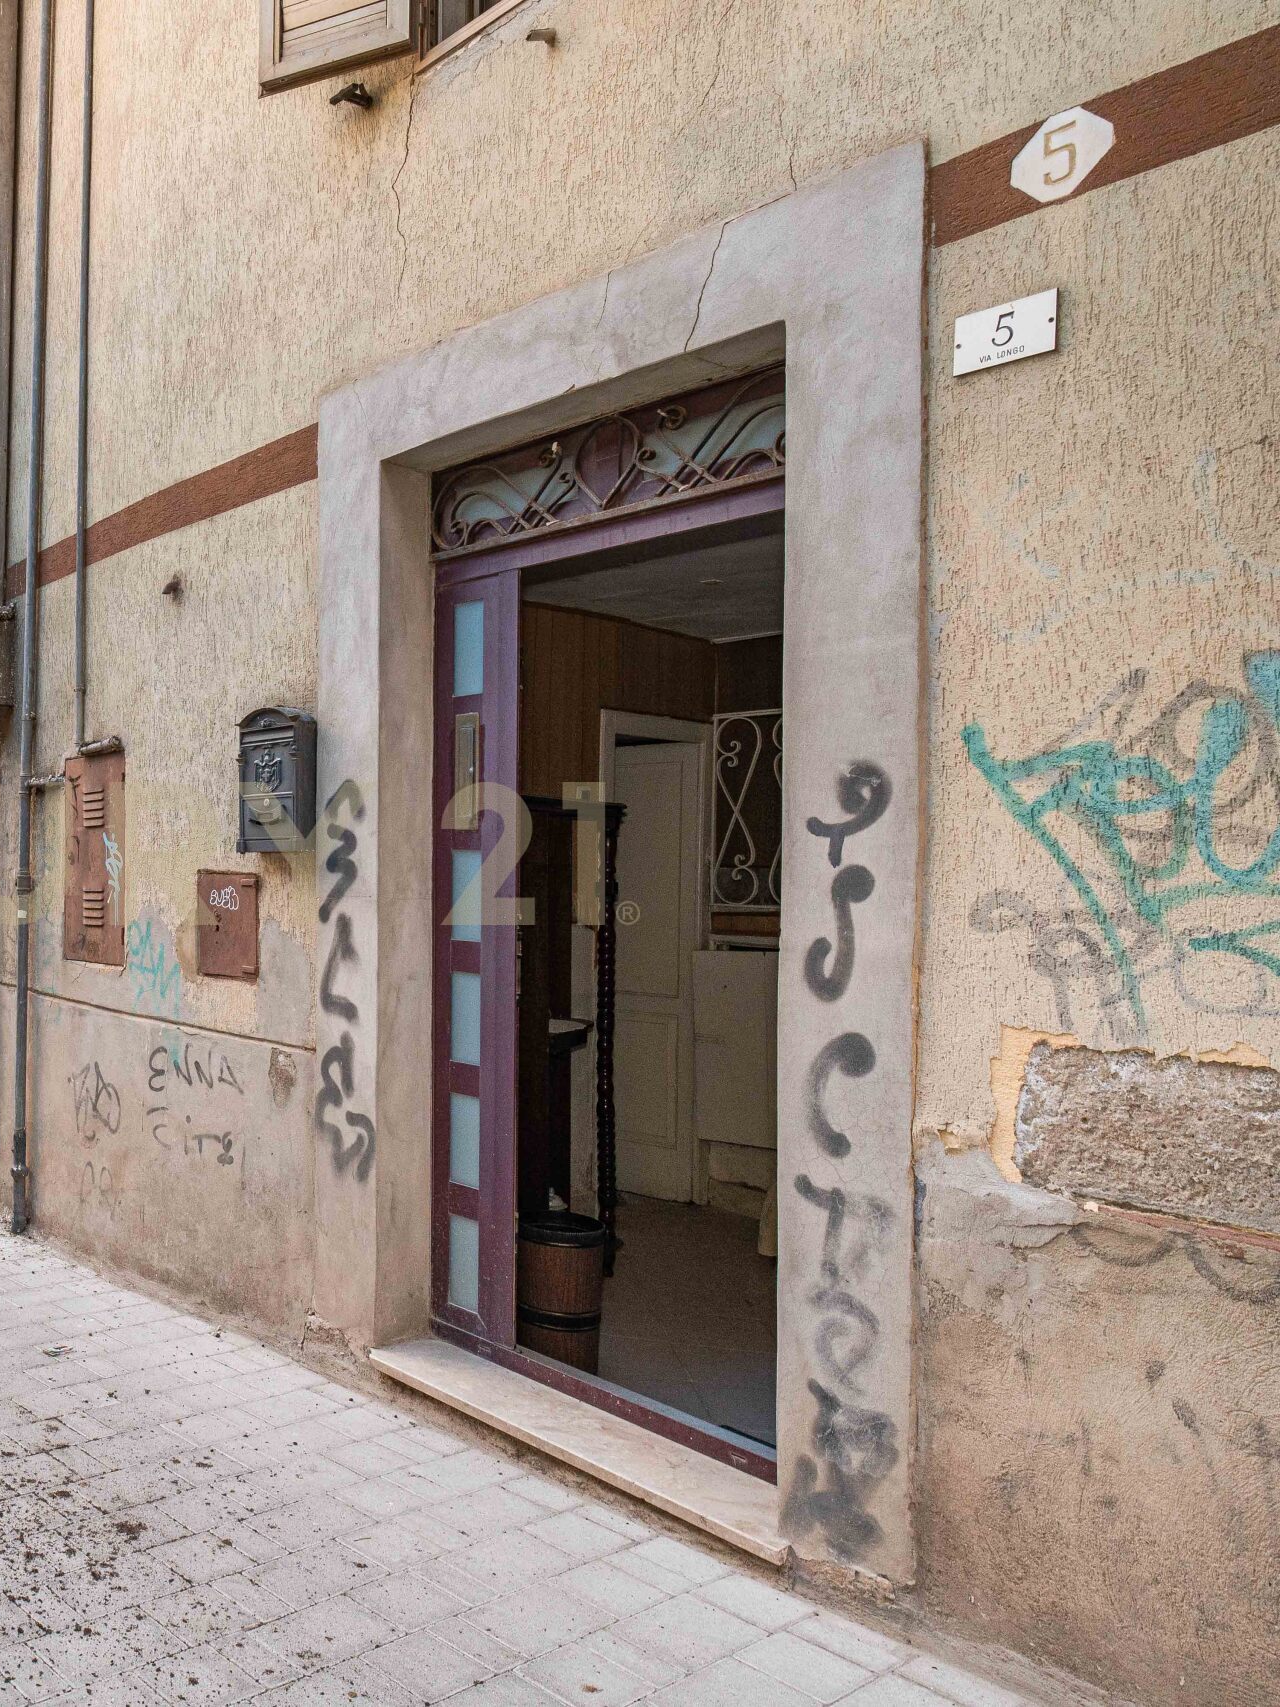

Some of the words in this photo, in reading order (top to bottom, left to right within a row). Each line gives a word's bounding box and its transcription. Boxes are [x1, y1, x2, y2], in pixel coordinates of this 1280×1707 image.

[1043, 119, 1077, 186] 5
[991, 310, 1015, 347] 5
[979, 354, 992, 364] VIA
[996, 345, 1025, 359] LONGO
